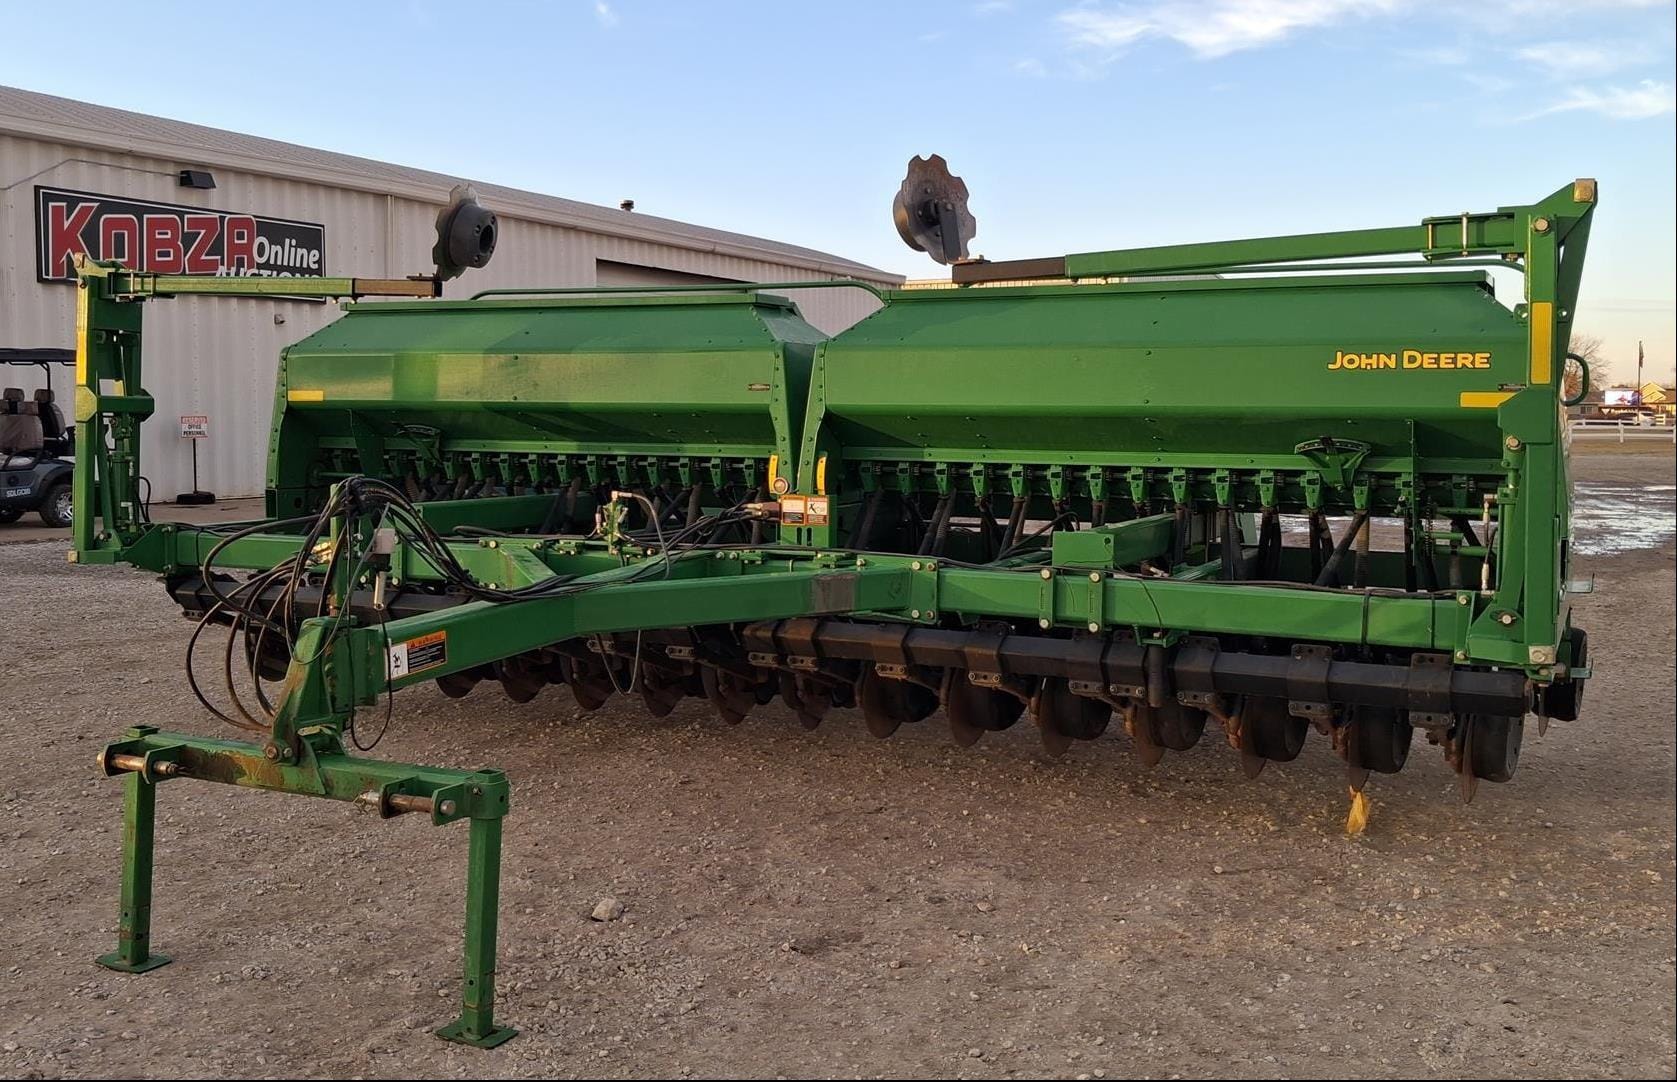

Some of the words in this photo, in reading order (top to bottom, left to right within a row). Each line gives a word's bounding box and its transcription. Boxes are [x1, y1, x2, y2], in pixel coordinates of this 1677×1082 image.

[49, 202, 257, 279] KOBZA
[252, 236, 320, 270] Online
[215, 265, 321, 278] AUCTI
[1327, 350, 1397, 370] JOHN
[1402, 349, 1492, 370] DEERE
